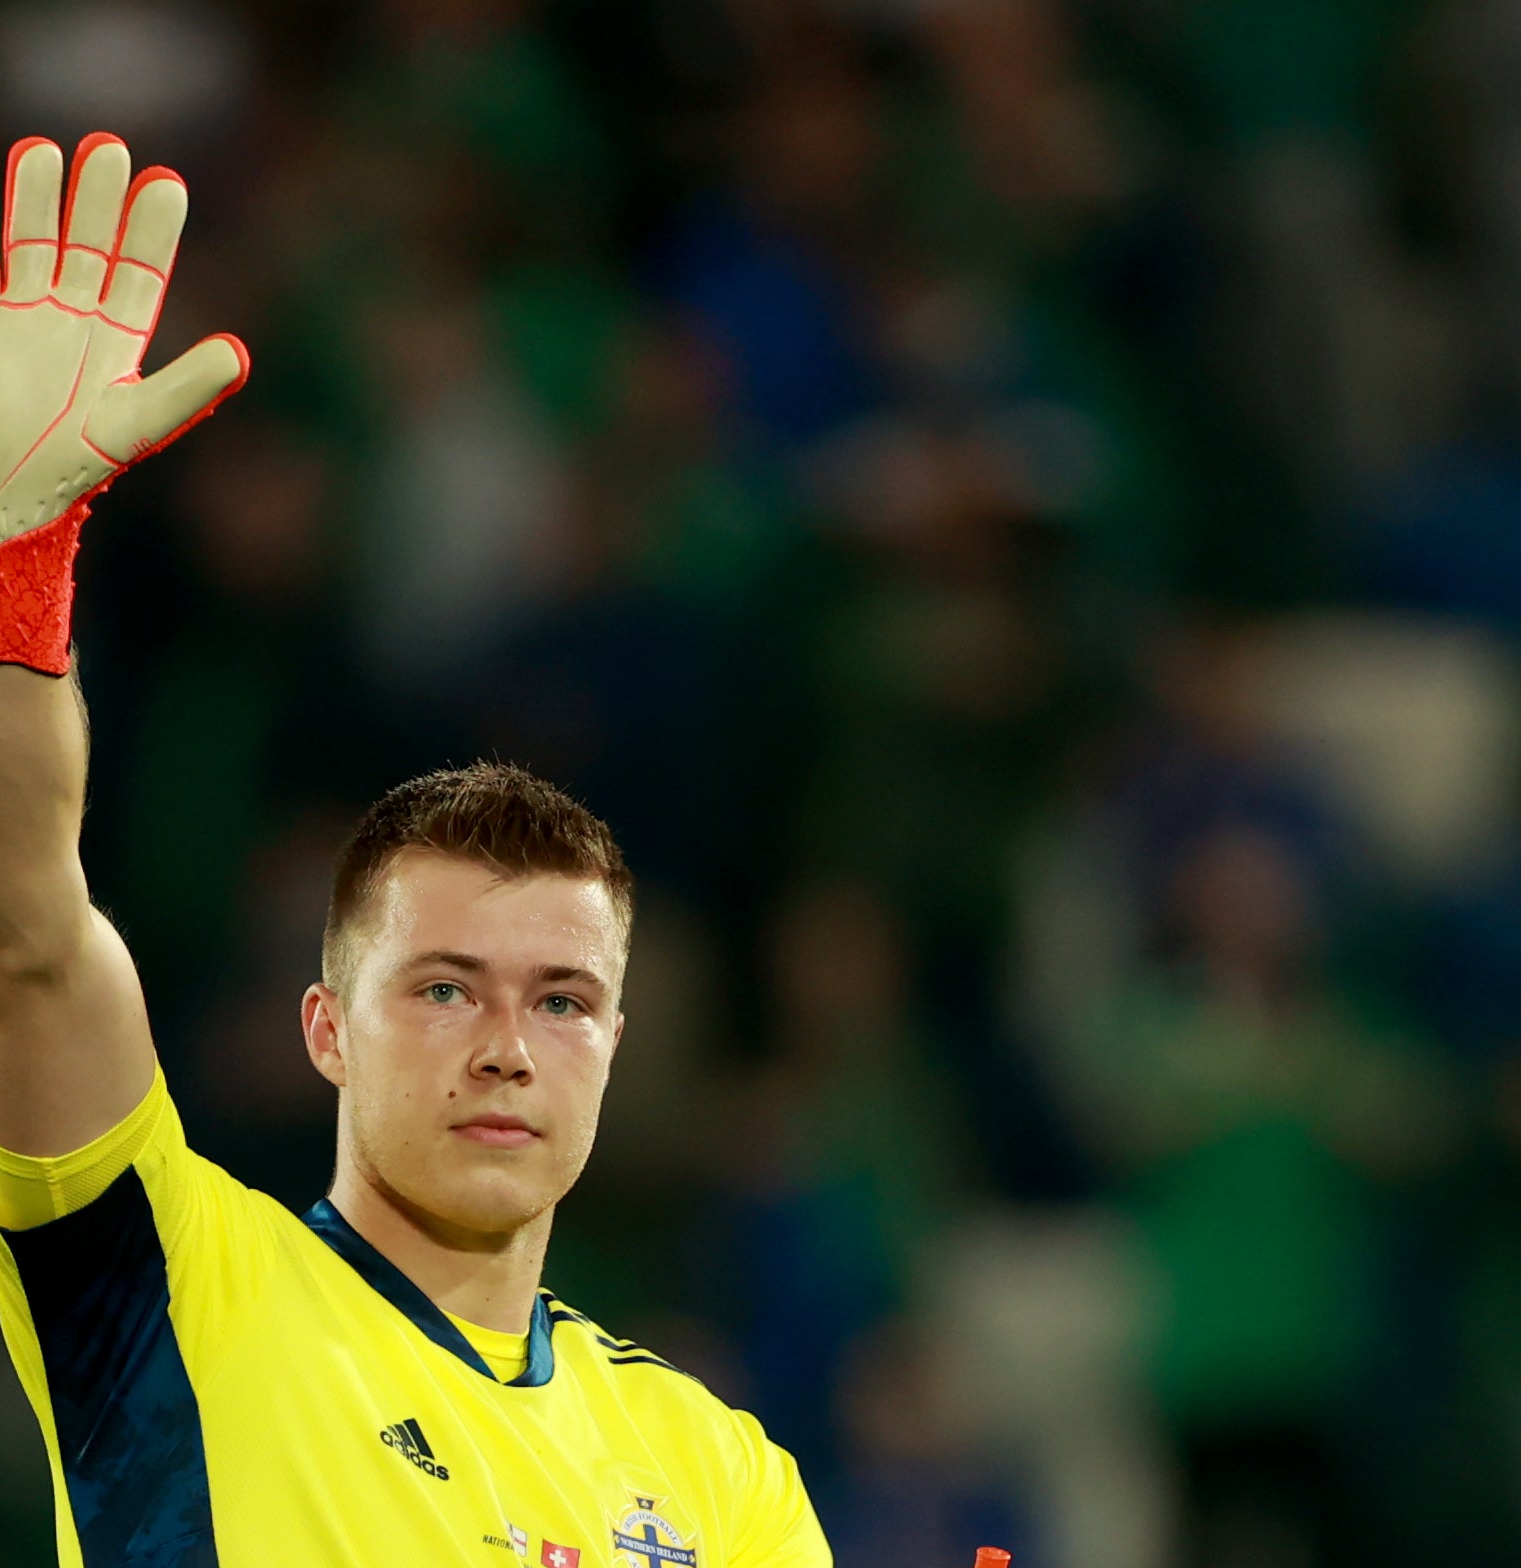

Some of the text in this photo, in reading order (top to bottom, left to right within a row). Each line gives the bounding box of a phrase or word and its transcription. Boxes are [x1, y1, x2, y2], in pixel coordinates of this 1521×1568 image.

[380, 1430, 449, 1481] adidas
[638, 1512, 678, 1544] FOOTBALL
[483, 1534, 515, 1552] NATIONA
[620, 1537, 688, 1562] NORTHERN IRELAND
